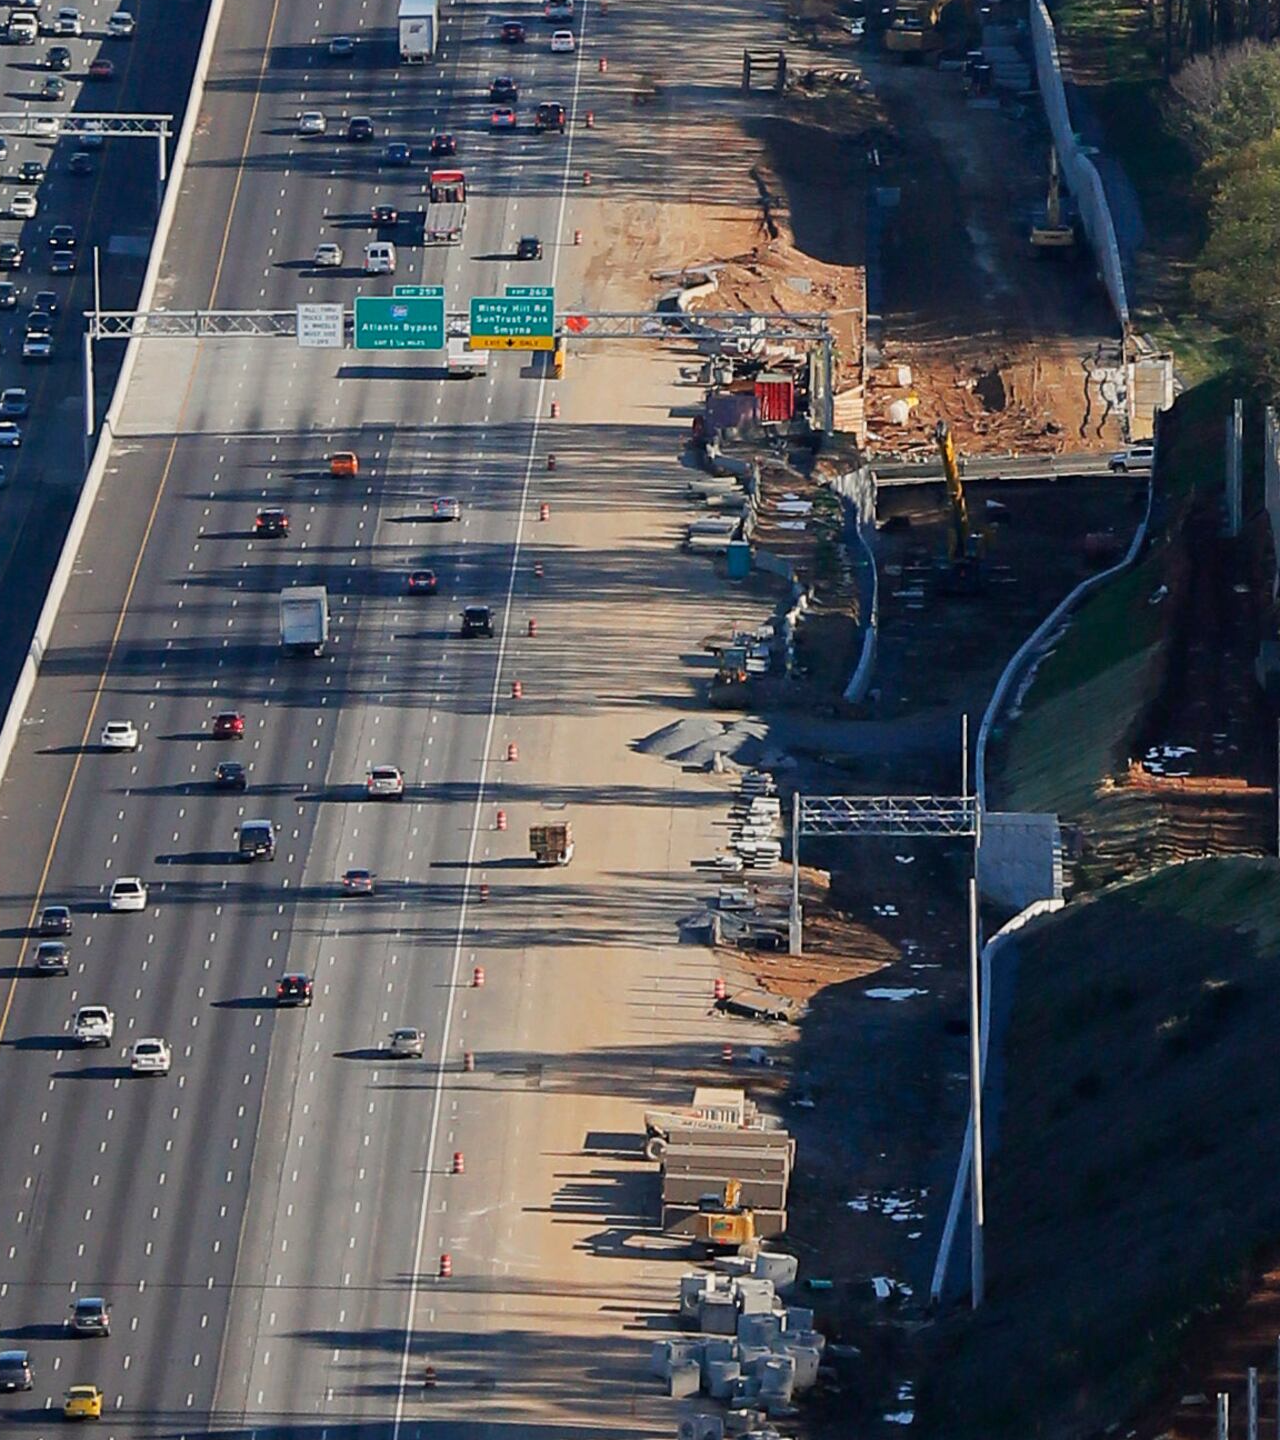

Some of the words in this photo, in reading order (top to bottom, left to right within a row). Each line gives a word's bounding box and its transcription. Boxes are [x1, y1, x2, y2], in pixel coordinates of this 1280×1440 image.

[530, 288, 548, 296] 260
[479, 304, 507, 314] Windy
[512, 304, 530, 313] Hill
[534, 304, 547, 313] Rd
[476, 315, 521, 323] SunTrust
[525, 315, 548, 323] Park
[362, 323, 399, 332] Atlanta
[403, 323, 438, 332] Bypass
[494, 325, 531, 335] Smyrna
